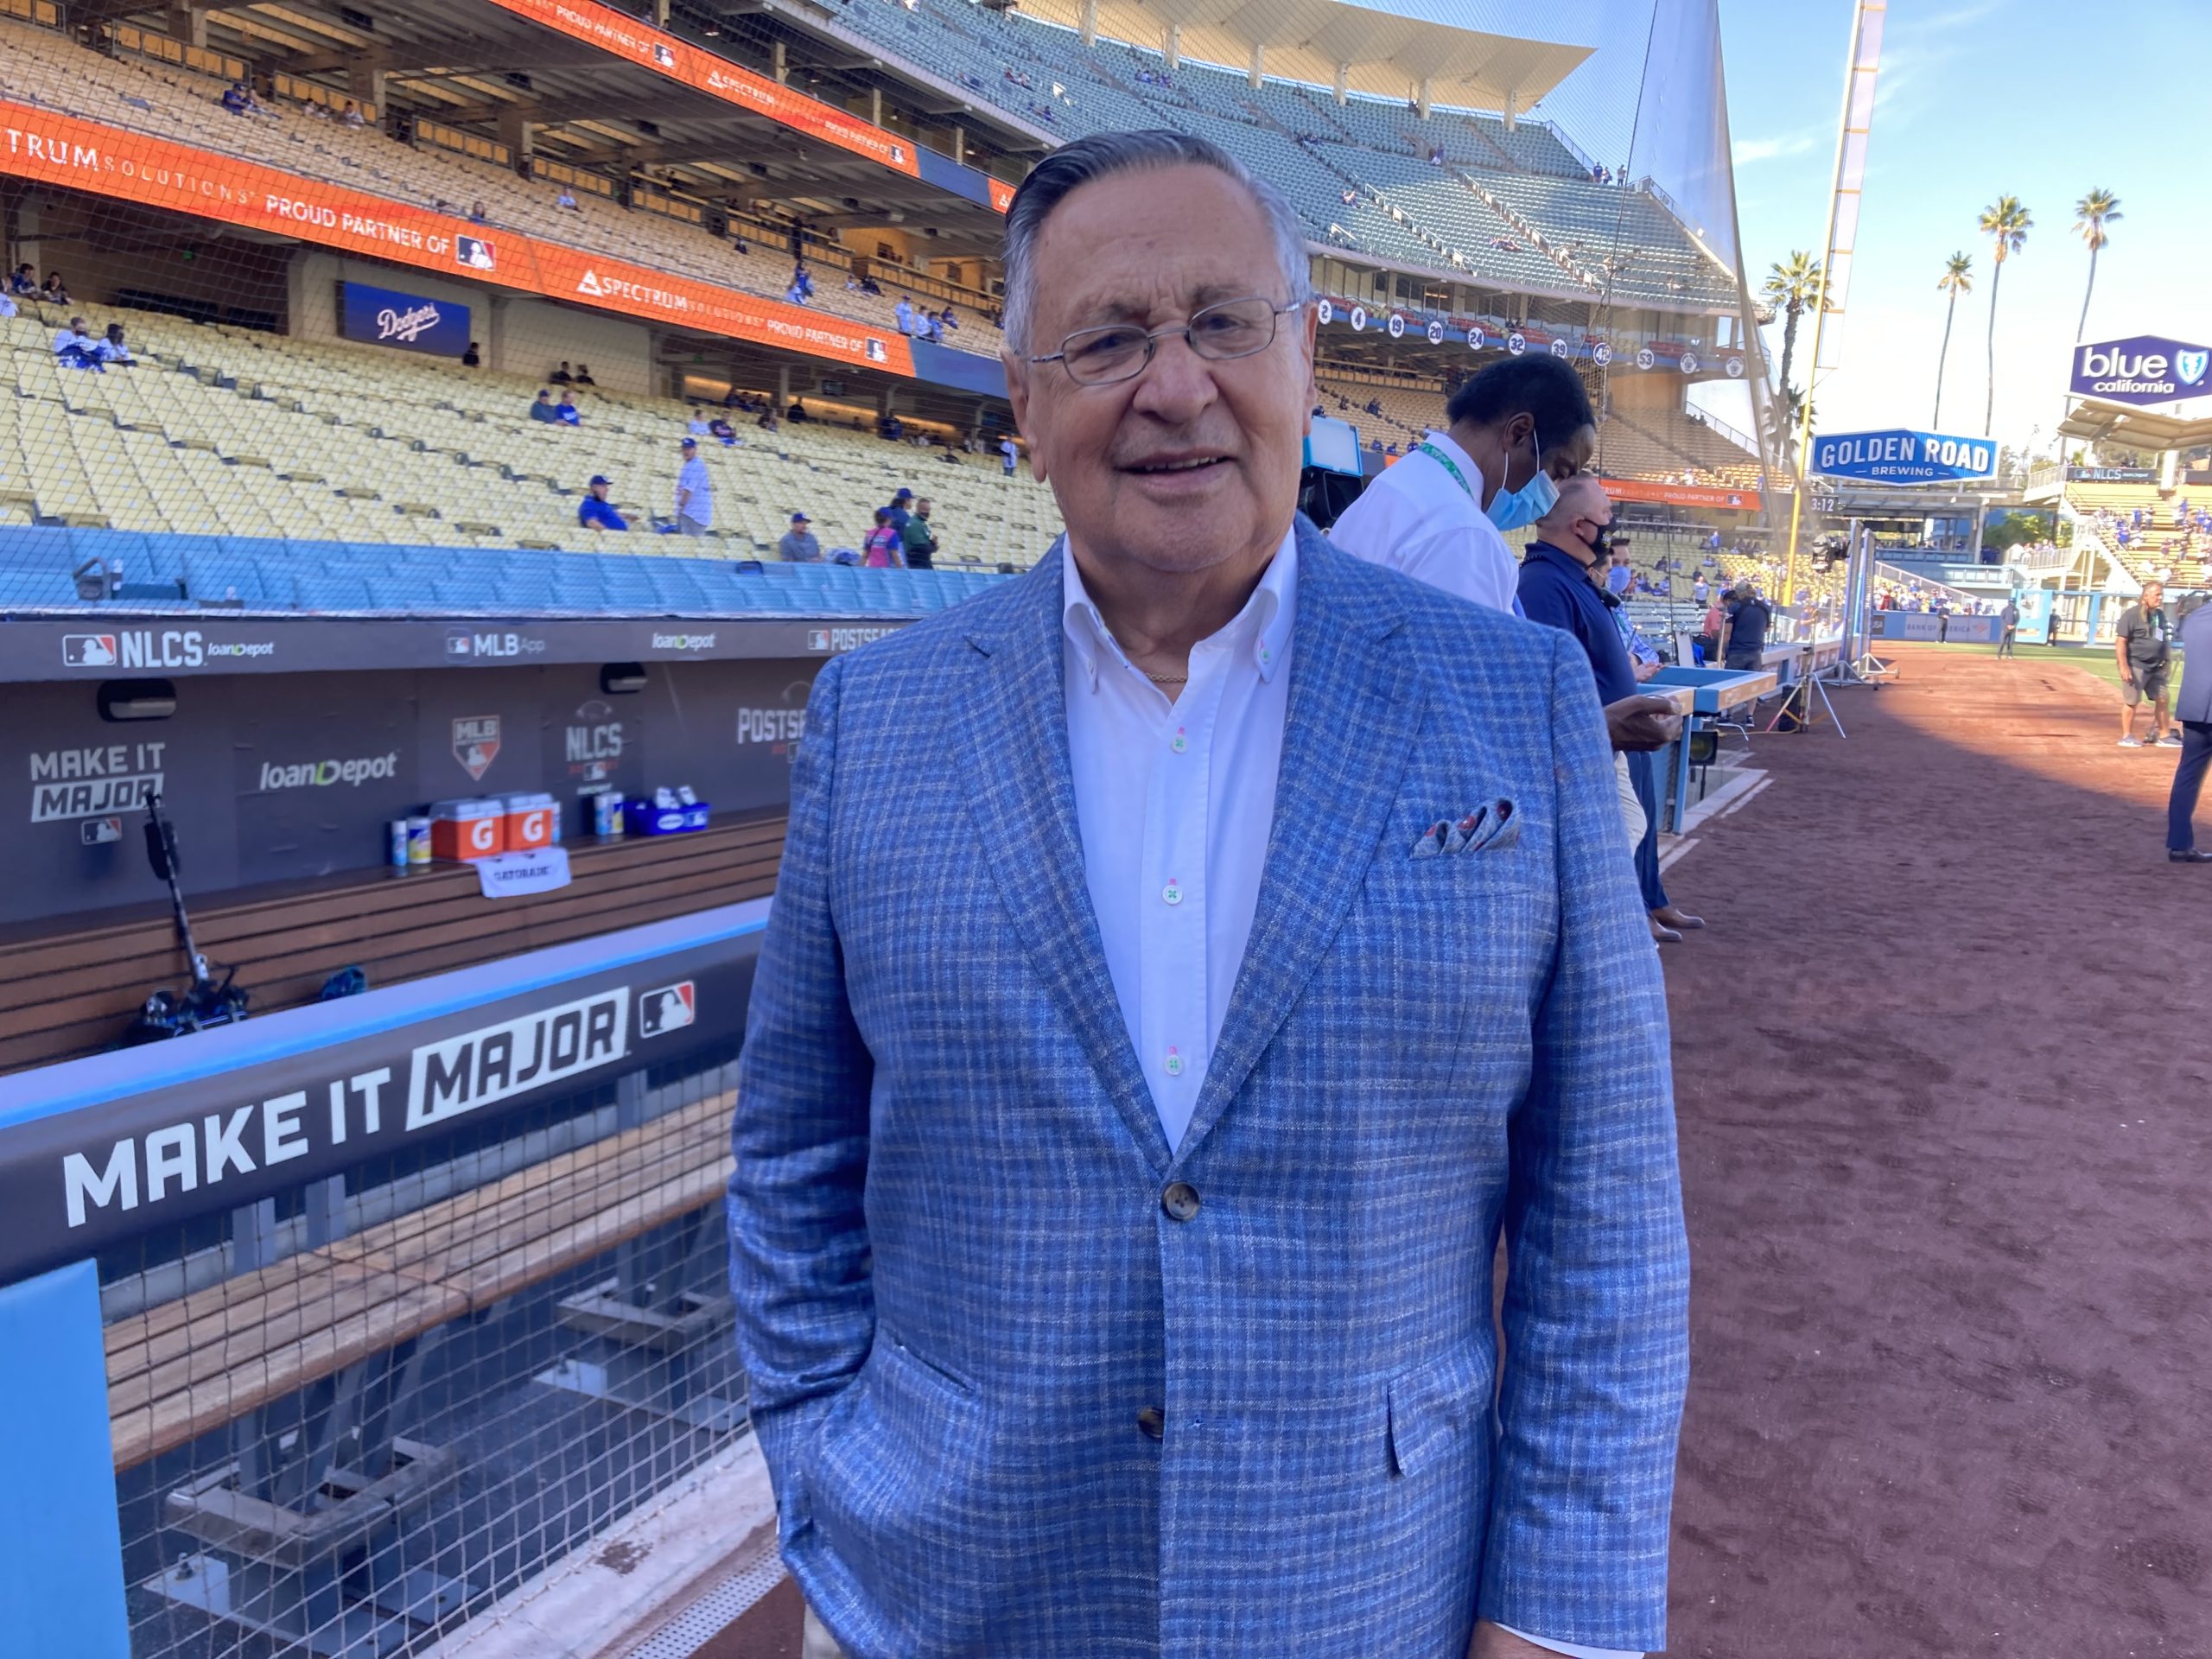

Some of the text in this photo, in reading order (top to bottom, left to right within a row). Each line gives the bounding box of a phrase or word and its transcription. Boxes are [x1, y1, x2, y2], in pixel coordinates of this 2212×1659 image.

[6, 129, 99, 172] TRUM
[265, 194, 336, 228] PROUD
[341, 213, 423, 248] PARTNER
[426, 235, 451, 255] OF
[377, 302, 441, 342] Dodgers
[602, 276, 689, 312] SPECTRUM
[767, 319, 804, 340] PROUD
[804, 328, 849, 351] PARTNER
[849, 339, 863, 353] OF
[1321, 305, 1328, 320] 2
[1354, 312, 1362, 327] 4
[1391, 319, 1402, 333] 19
[1428, 326, 1442, 339] 20
[1470, 332, 1483, 345] 24
[1511, 337, 1524, 351] 32
[1554, 344, 1566, 357] 39
[1638, 353, 1652, 365] 53
[2082, 346, 2168, 378] blue
[2092, 379, 2176, 394] california
[1821, 437, 1989, 473] GOLDEN ROAD
[1872, 466, 1934, 476] BREWING
[2093, 468, 2122, 480] NLCS
[1664, 492, 1685, 500] PROUD
[1687, 493, 1714, 502] PARTNER
[1811, 498, 1834, 512] 3:12
[121, 631, 274, 668] NLCS loanDepot
[474, 633, 546, 657] MLB App
[652, 632, 715, 652] loanDepot
[456, 720, 497, 740] MLB
[567, 722, 623, 761] NLCS
[30, 742, 165, 781] MAKE IT
[260, 752, 397, 791] loanDepot
[40, 779, 156, 817] MAJOR
[472, 818, 493, 850] G
[522, 812, 544, 842] G
[421, 996, 620, 1116] MAJOR
[63, 1068, 391, 1230] MAKE IT
